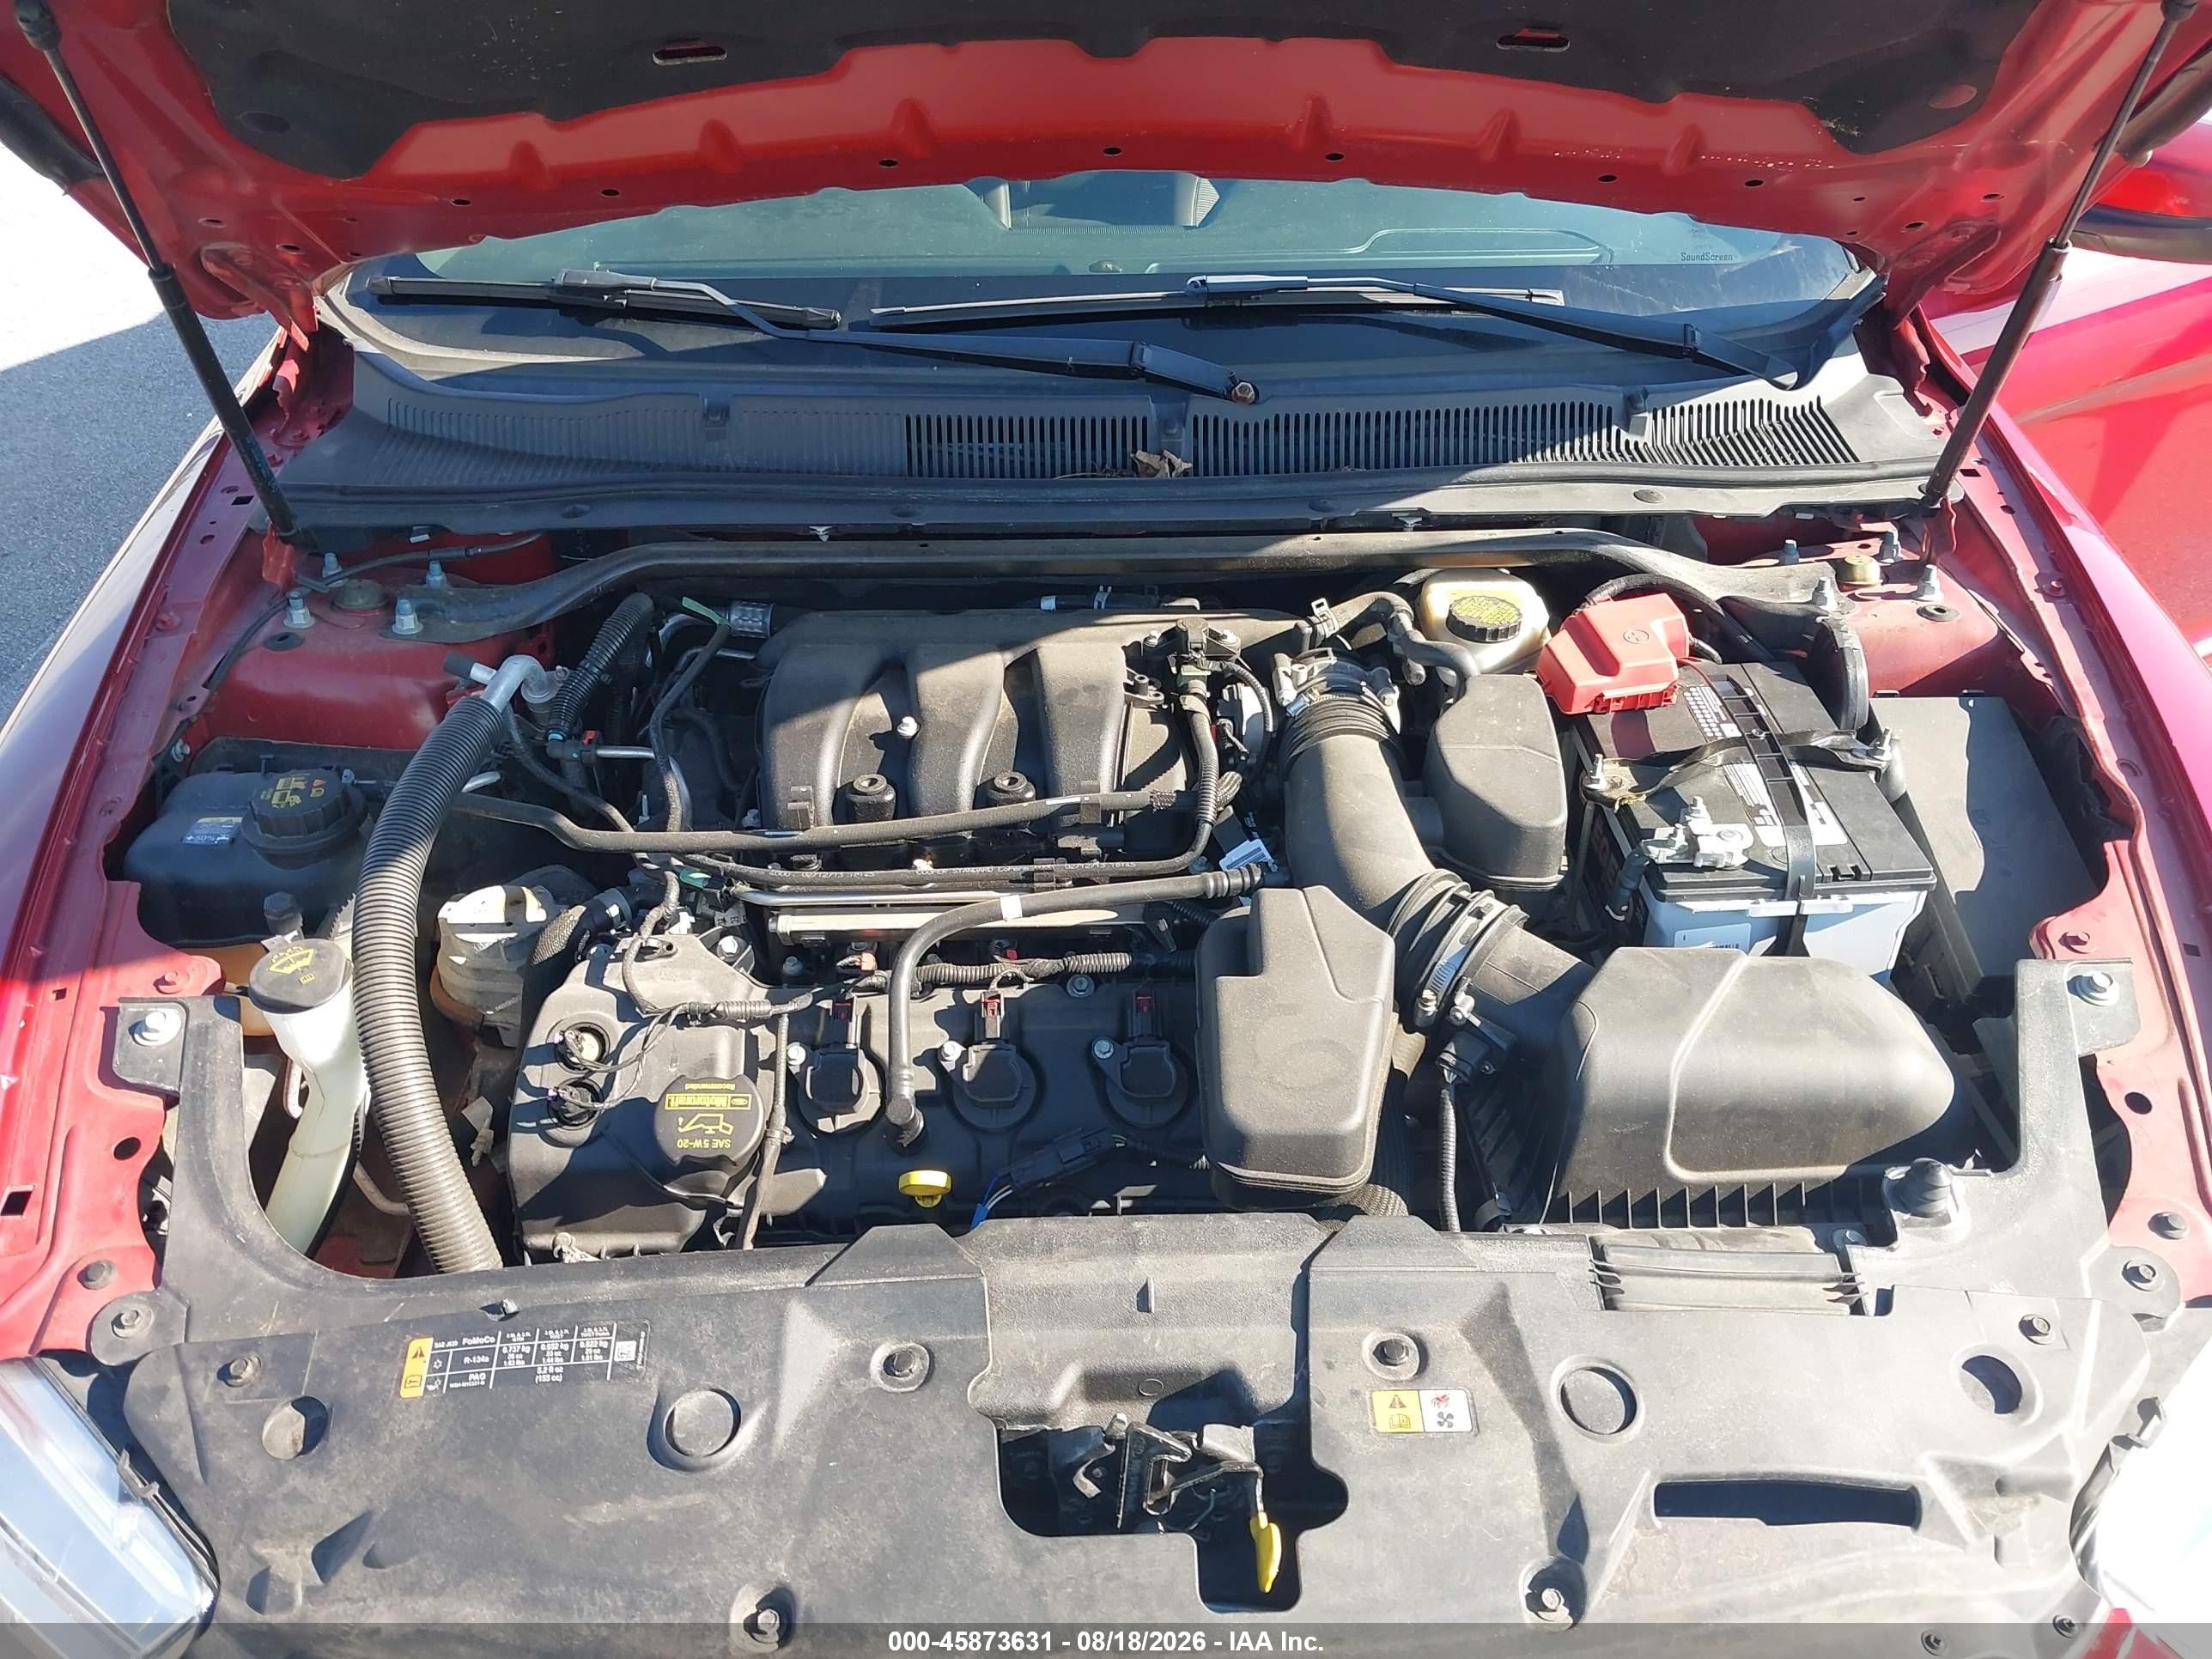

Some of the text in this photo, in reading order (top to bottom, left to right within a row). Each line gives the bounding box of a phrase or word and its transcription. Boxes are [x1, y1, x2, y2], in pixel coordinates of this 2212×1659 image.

[1680, 252, 1733, 261] SoundScreen
[712, 1139, 732, 1149] SAE
[462, 1335, 495, 1346] FoMoCo
[599, 1340, 608, 1348] kg
[522, 1345, 531, 1353] kg
[560, 1342, 569, 1351] kg
[464, 1354, 489, 1365] R-134a
[551, 1374, 563, 1382] cc)
